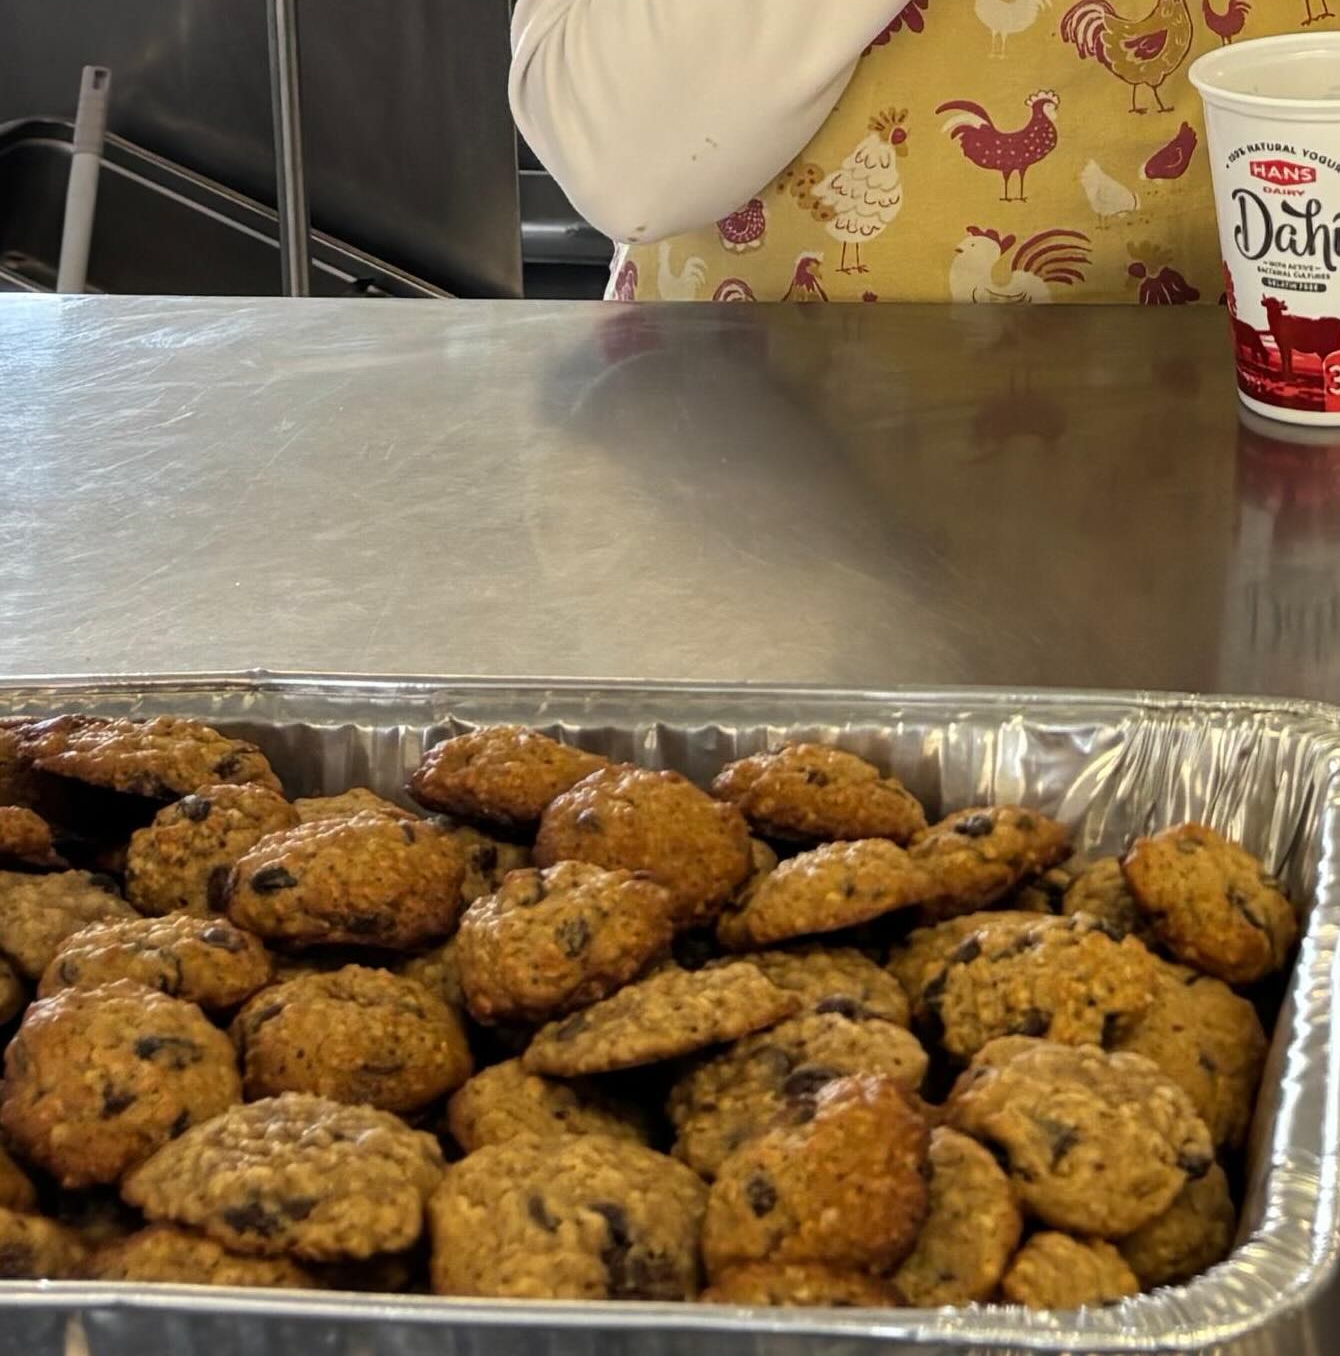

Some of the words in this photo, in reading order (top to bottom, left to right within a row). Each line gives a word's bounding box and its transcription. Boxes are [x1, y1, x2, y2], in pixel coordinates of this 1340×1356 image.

[1246, 142, 1297, 155] NATURAL
[1252, 163, 1313, 182] HANS
[1262, 186, 1305, 197] DAIRY
